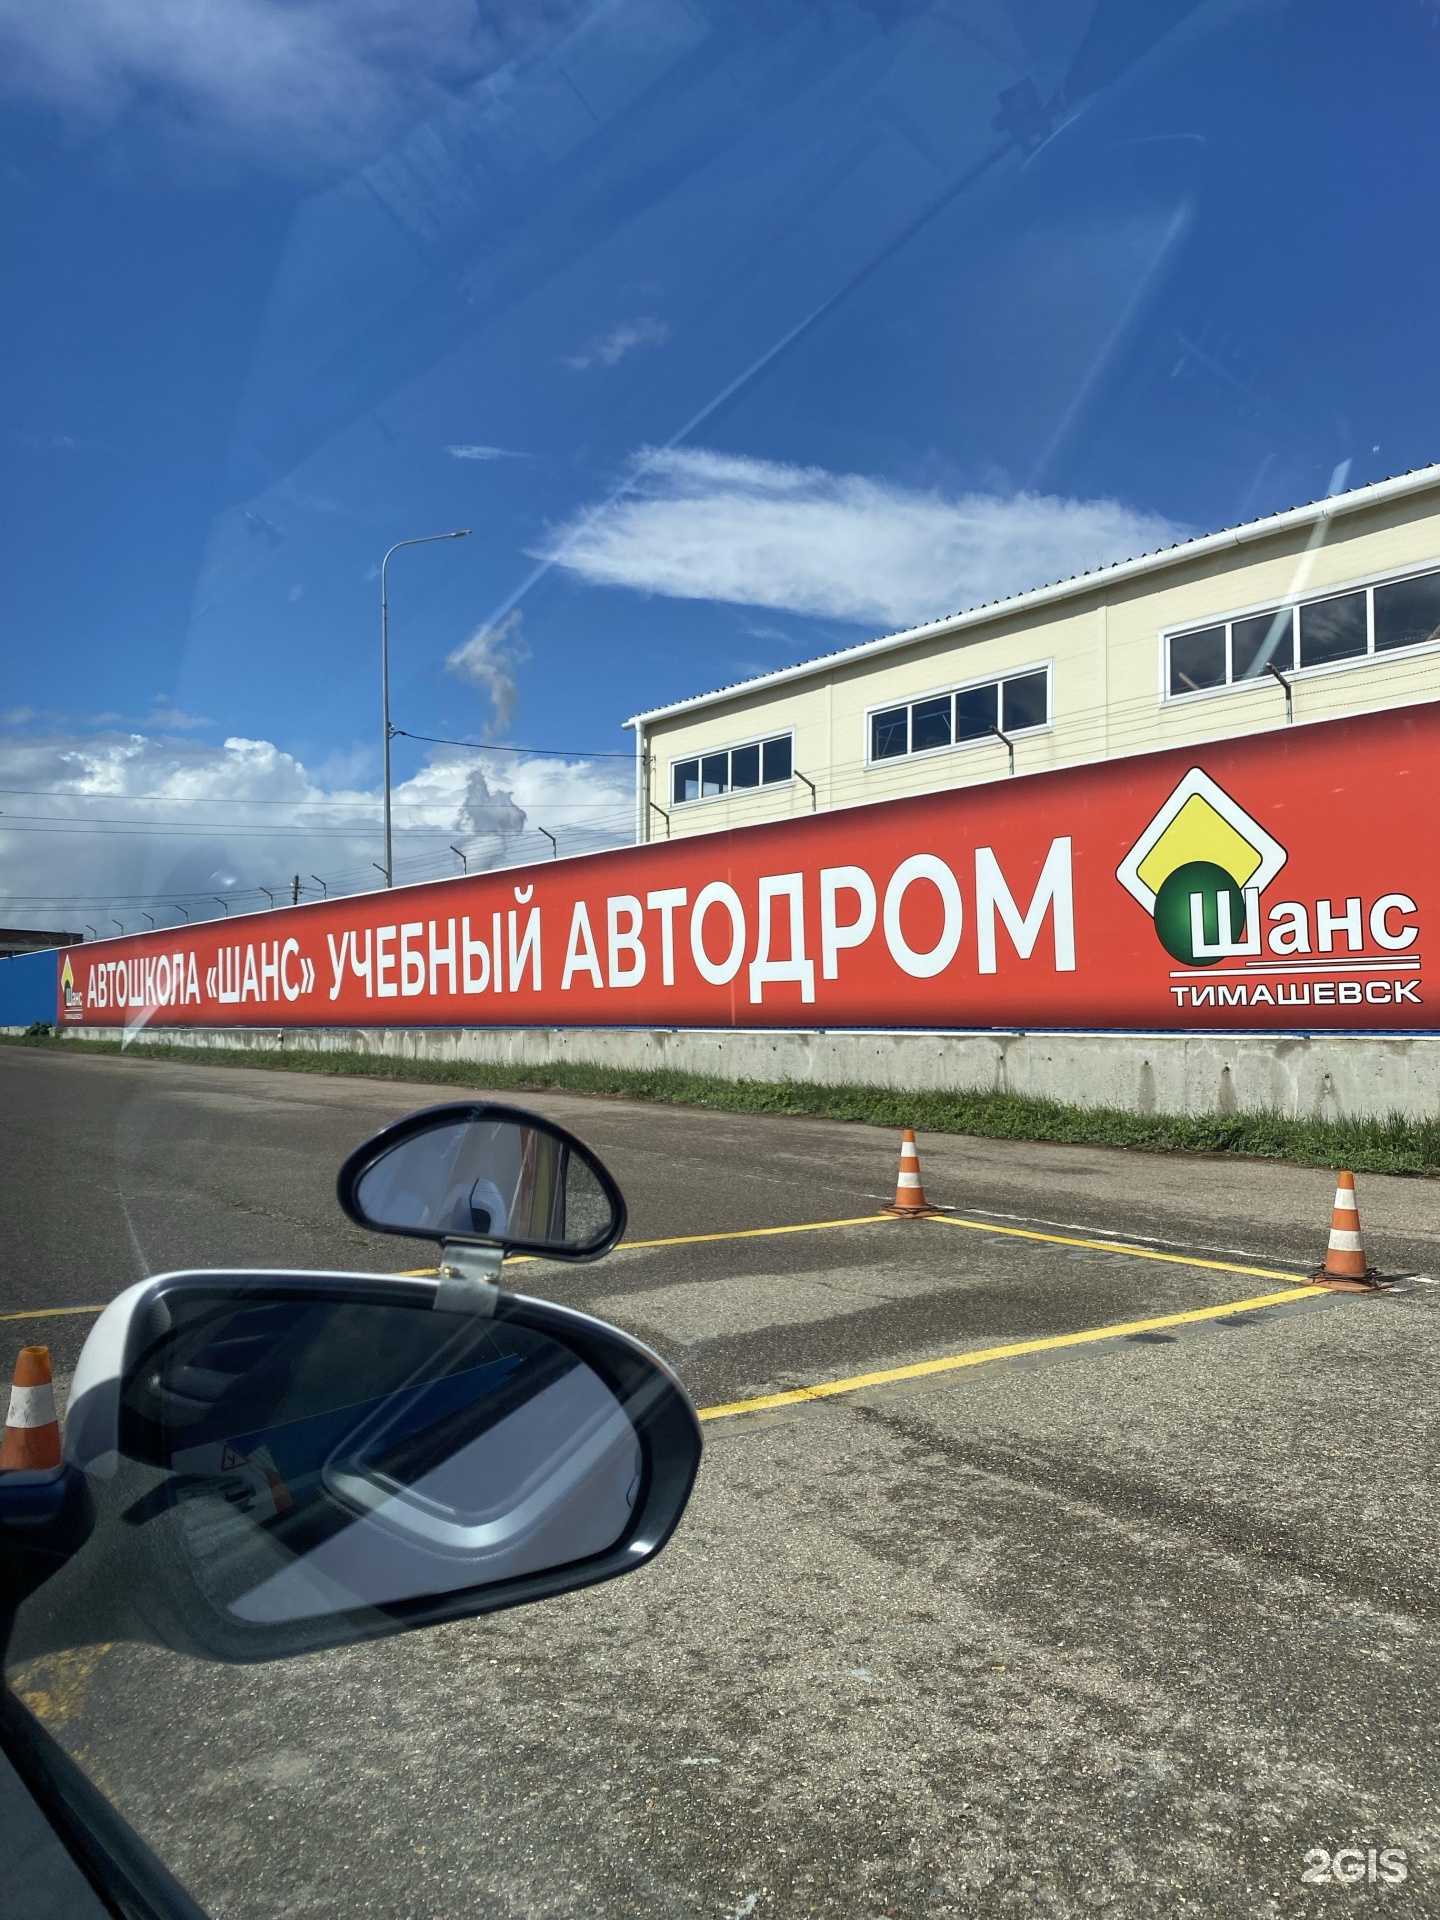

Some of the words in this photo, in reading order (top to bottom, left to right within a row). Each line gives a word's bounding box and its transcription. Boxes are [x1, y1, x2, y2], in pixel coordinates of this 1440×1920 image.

[87, 951, 200, 1008] АВТОШКОЛА
[206, 938, 315, 1003] «ШАНС»
[327, 884, 542, 1001] УЧЕБНЫЙ
[561, 836, 1076, 1004] АВТОДРОМ
[1188, 886, 1420, 958] Шанс
[1169, 980, 1422, 1007] ТИМАШЕВСК
